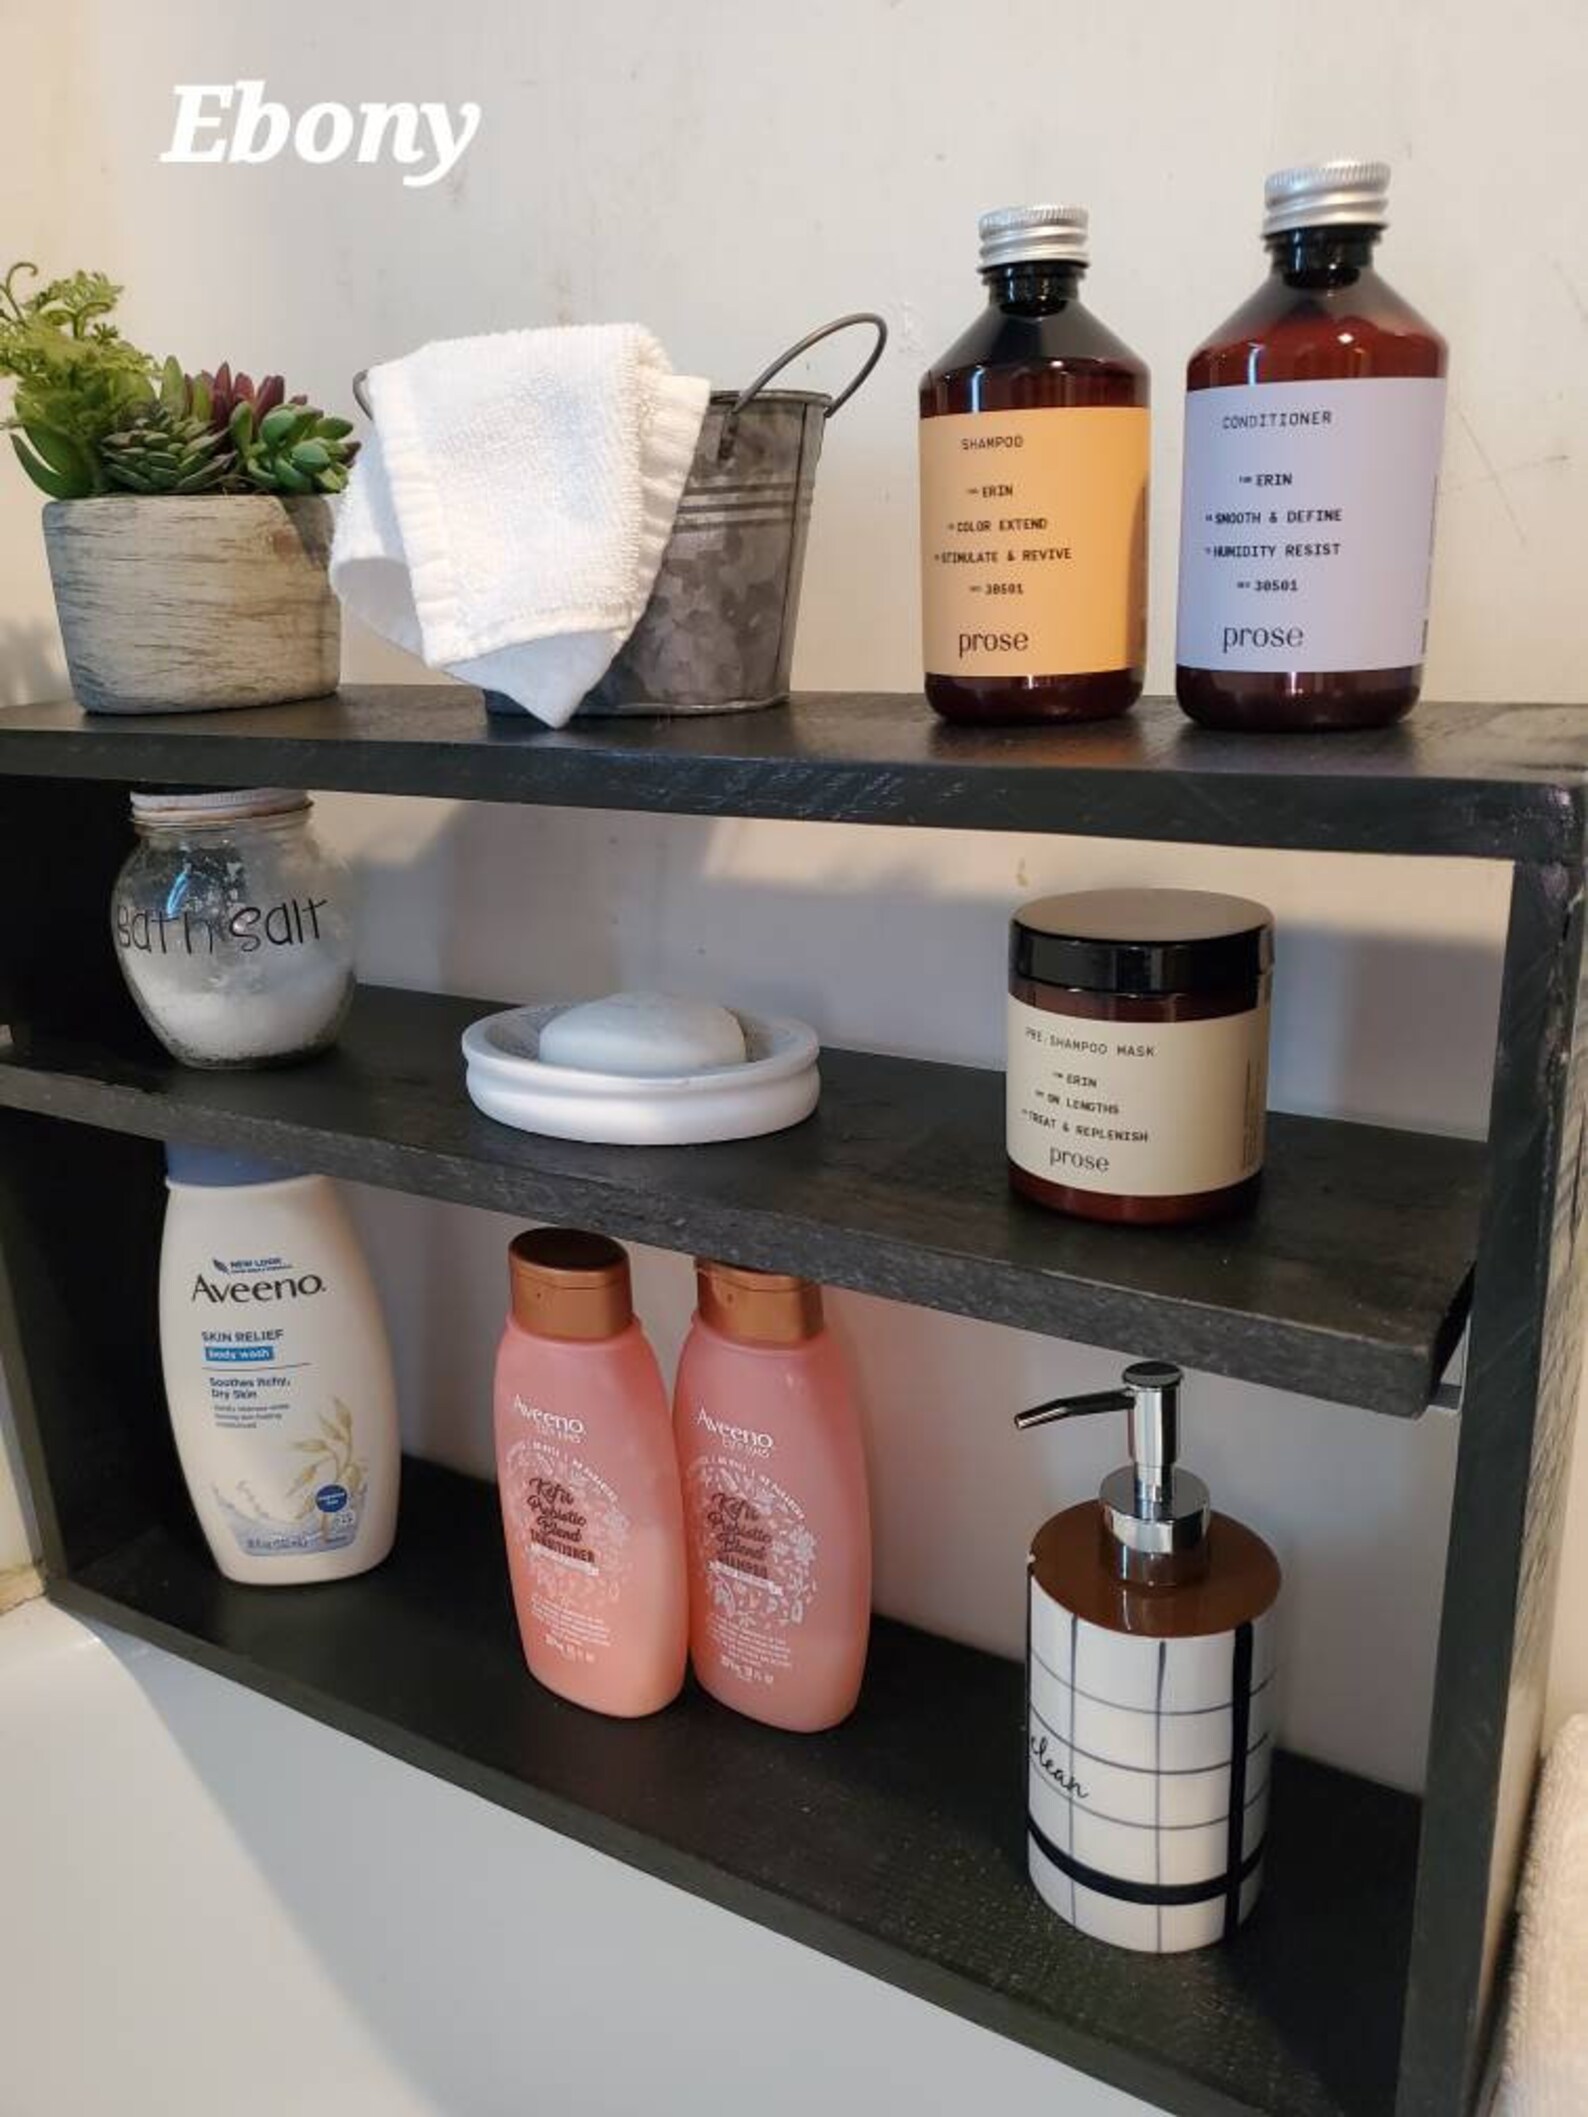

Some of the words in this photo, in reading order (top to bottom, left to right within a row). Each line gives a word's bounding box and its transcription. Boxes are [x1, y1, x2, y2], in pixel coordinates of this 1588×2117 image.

[1222, 411, 1333, 430] CONDITIONER
[961, 435, 1024, 450] SHAMPOO
[1255, 473, 1293, 487] ERIN
[982, 484, 1014, 498] ERIN
[1214, 511, 1261, 525] SMOOTH
[1268, 511, 1278, 524] &
[1287, 509, 1343, 523] DEFINE
[957, 520, 991, 533] COLOR
[999, 518, 1047, 531] EXTEND
[941, 551, 998, 564] STIMULATE
[1007, 551, 1016, 562] &
[1022, 548, 1073, 562] REVIVE
[1213, 545, 1276, 559] HUMIDITY
[1285, 543, 1342, 557] RESIST
[1254, 579, 1299, 592] 30501
[958, 630, 1030, 658] prose
[1222, 624, 1305, 655] prose
[230, 898, 328, 953] salt
[1116, 1045, 1156, 1058] MASK
[1066, 1073, 1098, 1089] ERIN
[1066, 1098, 1120, 1115] LENGTHS
[1028, 1110, 1057, 1129] TREAT
[1075, 1124, 1149, 1143] REPLENISH
[1049, 1146, 1110, 1173] prose
[192, 1273, 323, 1303] Aveeno
[201, 1331, 232, 1342] SKIN
[234, 1329, 284, 1342] RELIEF
[240, 1348, 270, 1359] wash
[209, 1377, 254, 1388] Soothes
[1030, 1736, 1089, 1798] clean
